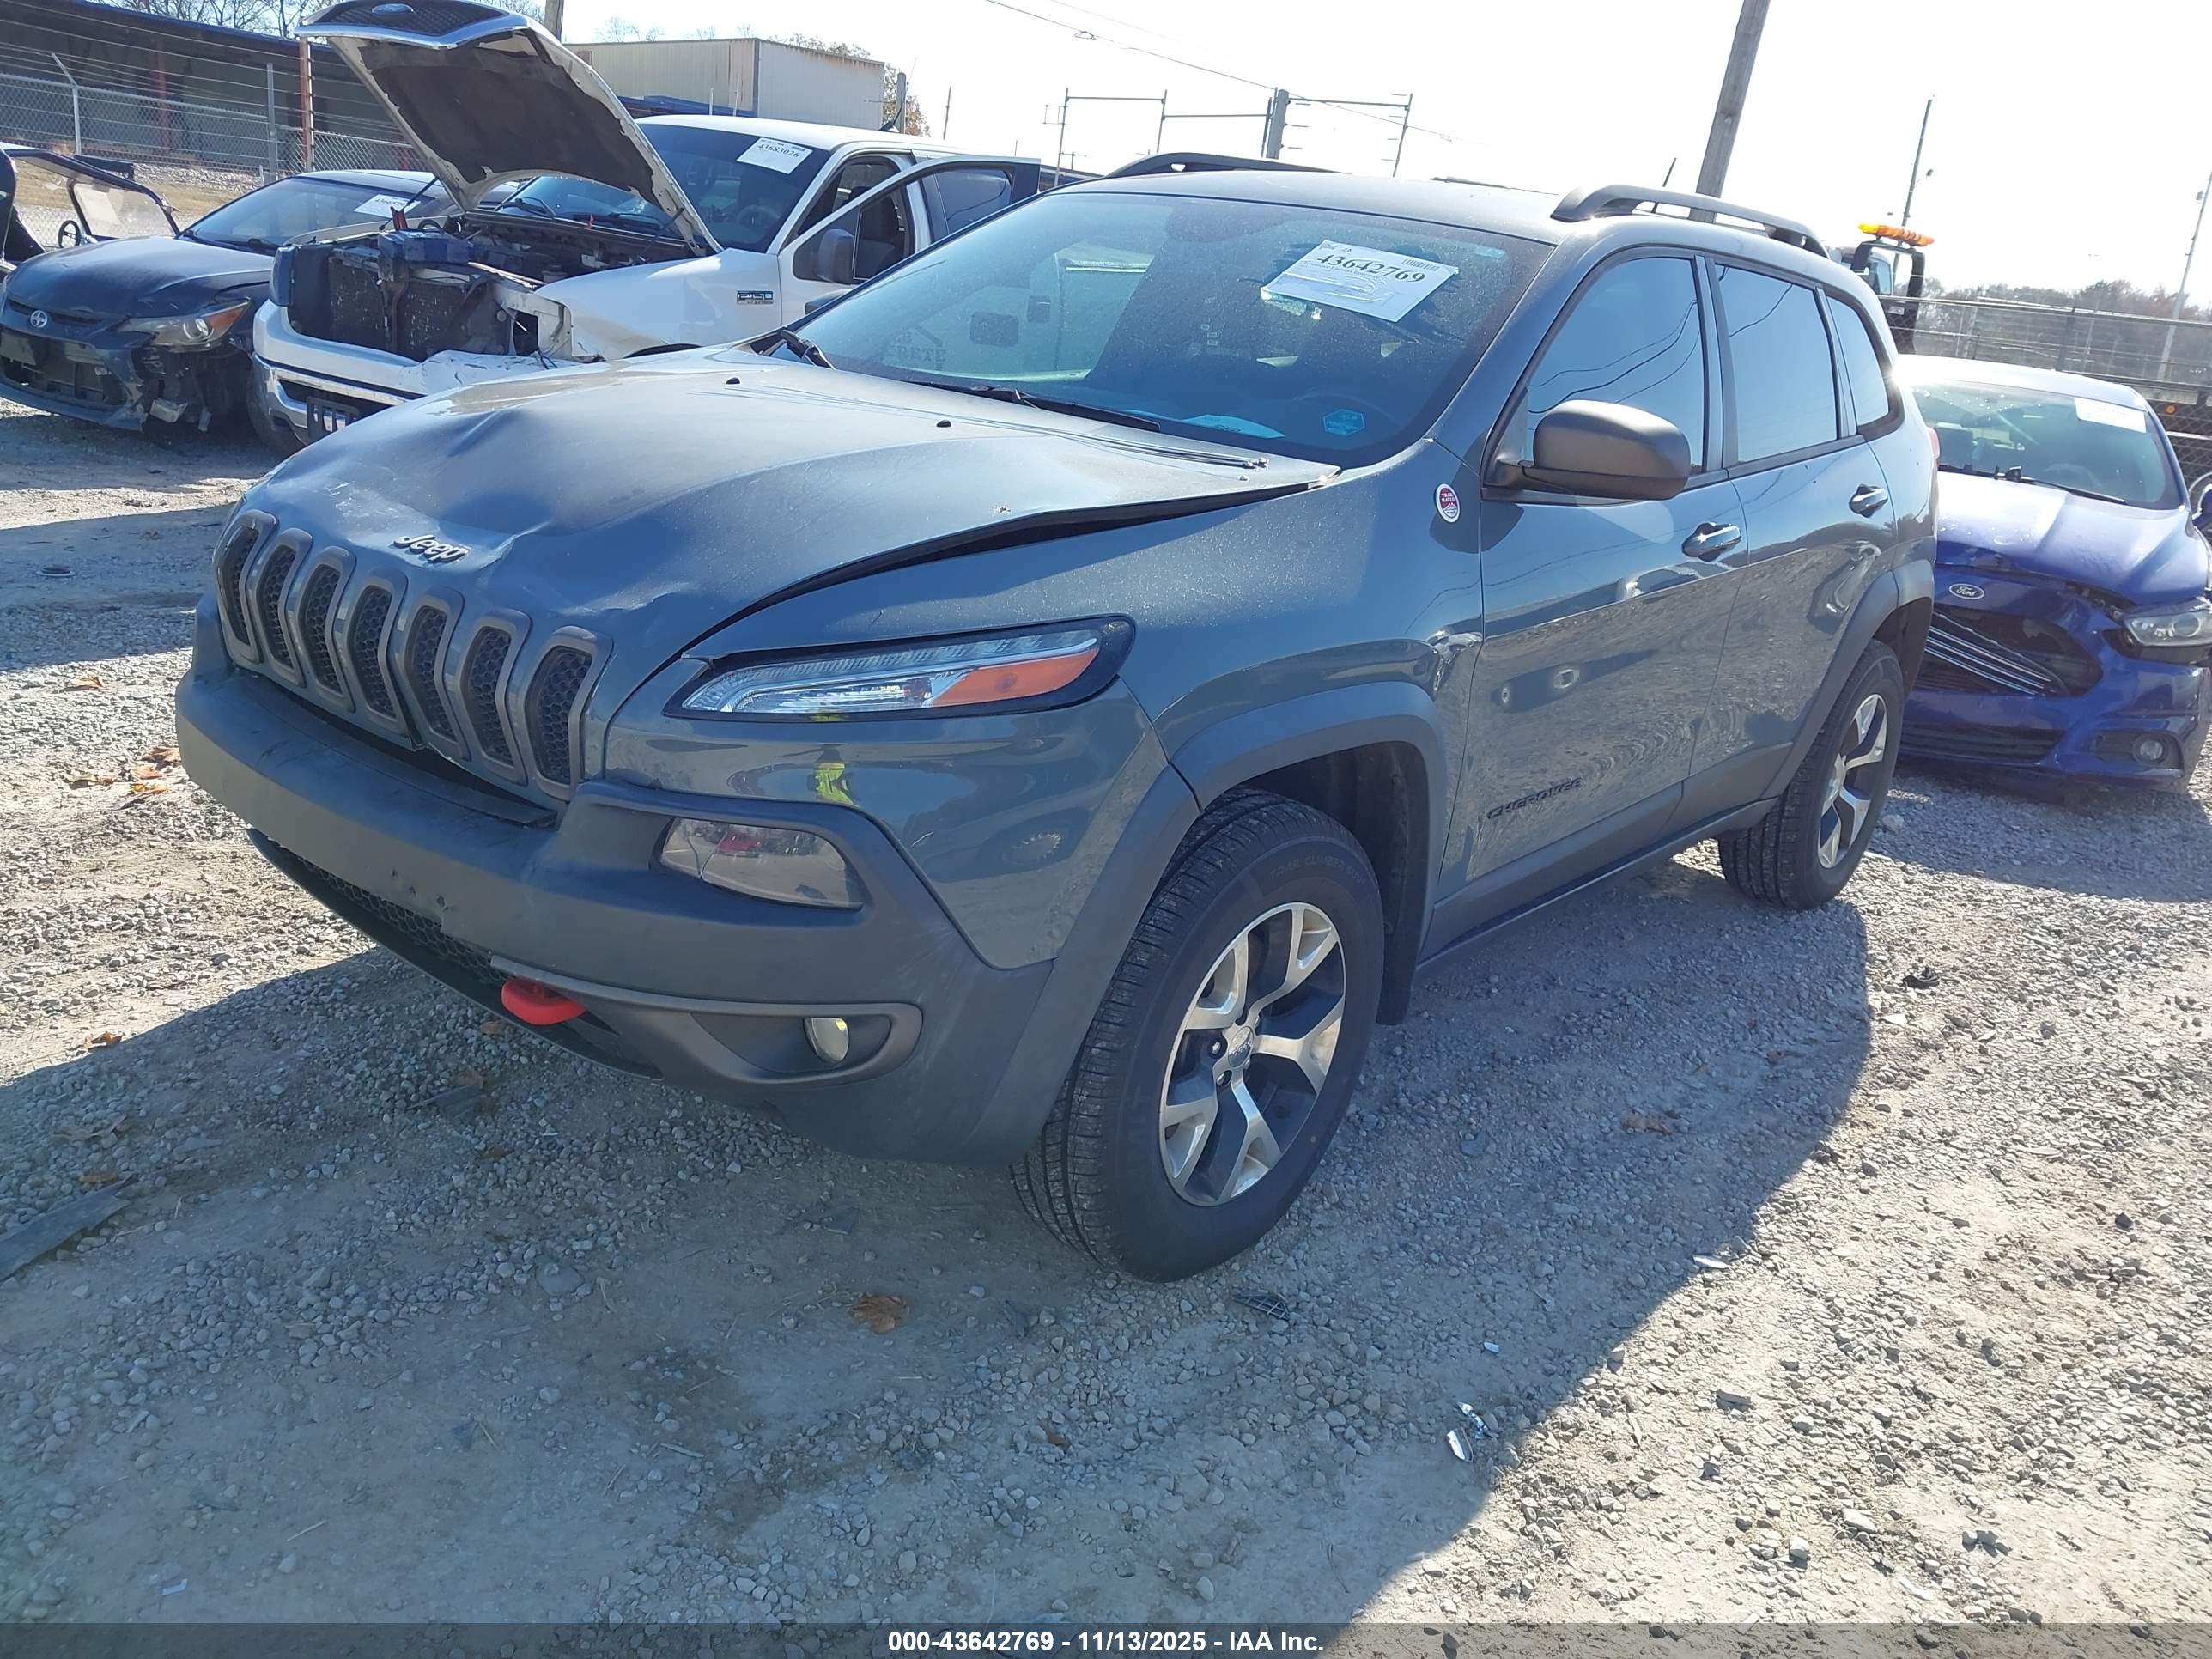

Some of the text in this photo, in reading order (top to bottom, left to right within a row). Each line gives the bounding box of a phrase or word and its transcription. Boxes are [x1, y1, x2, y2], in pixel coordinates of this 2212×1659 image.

[1316, 253, 1426, 283] 43642769
[393, 534, 470, 564] Jeep
[1486, 776, 1582, 820] CHEROKEE
